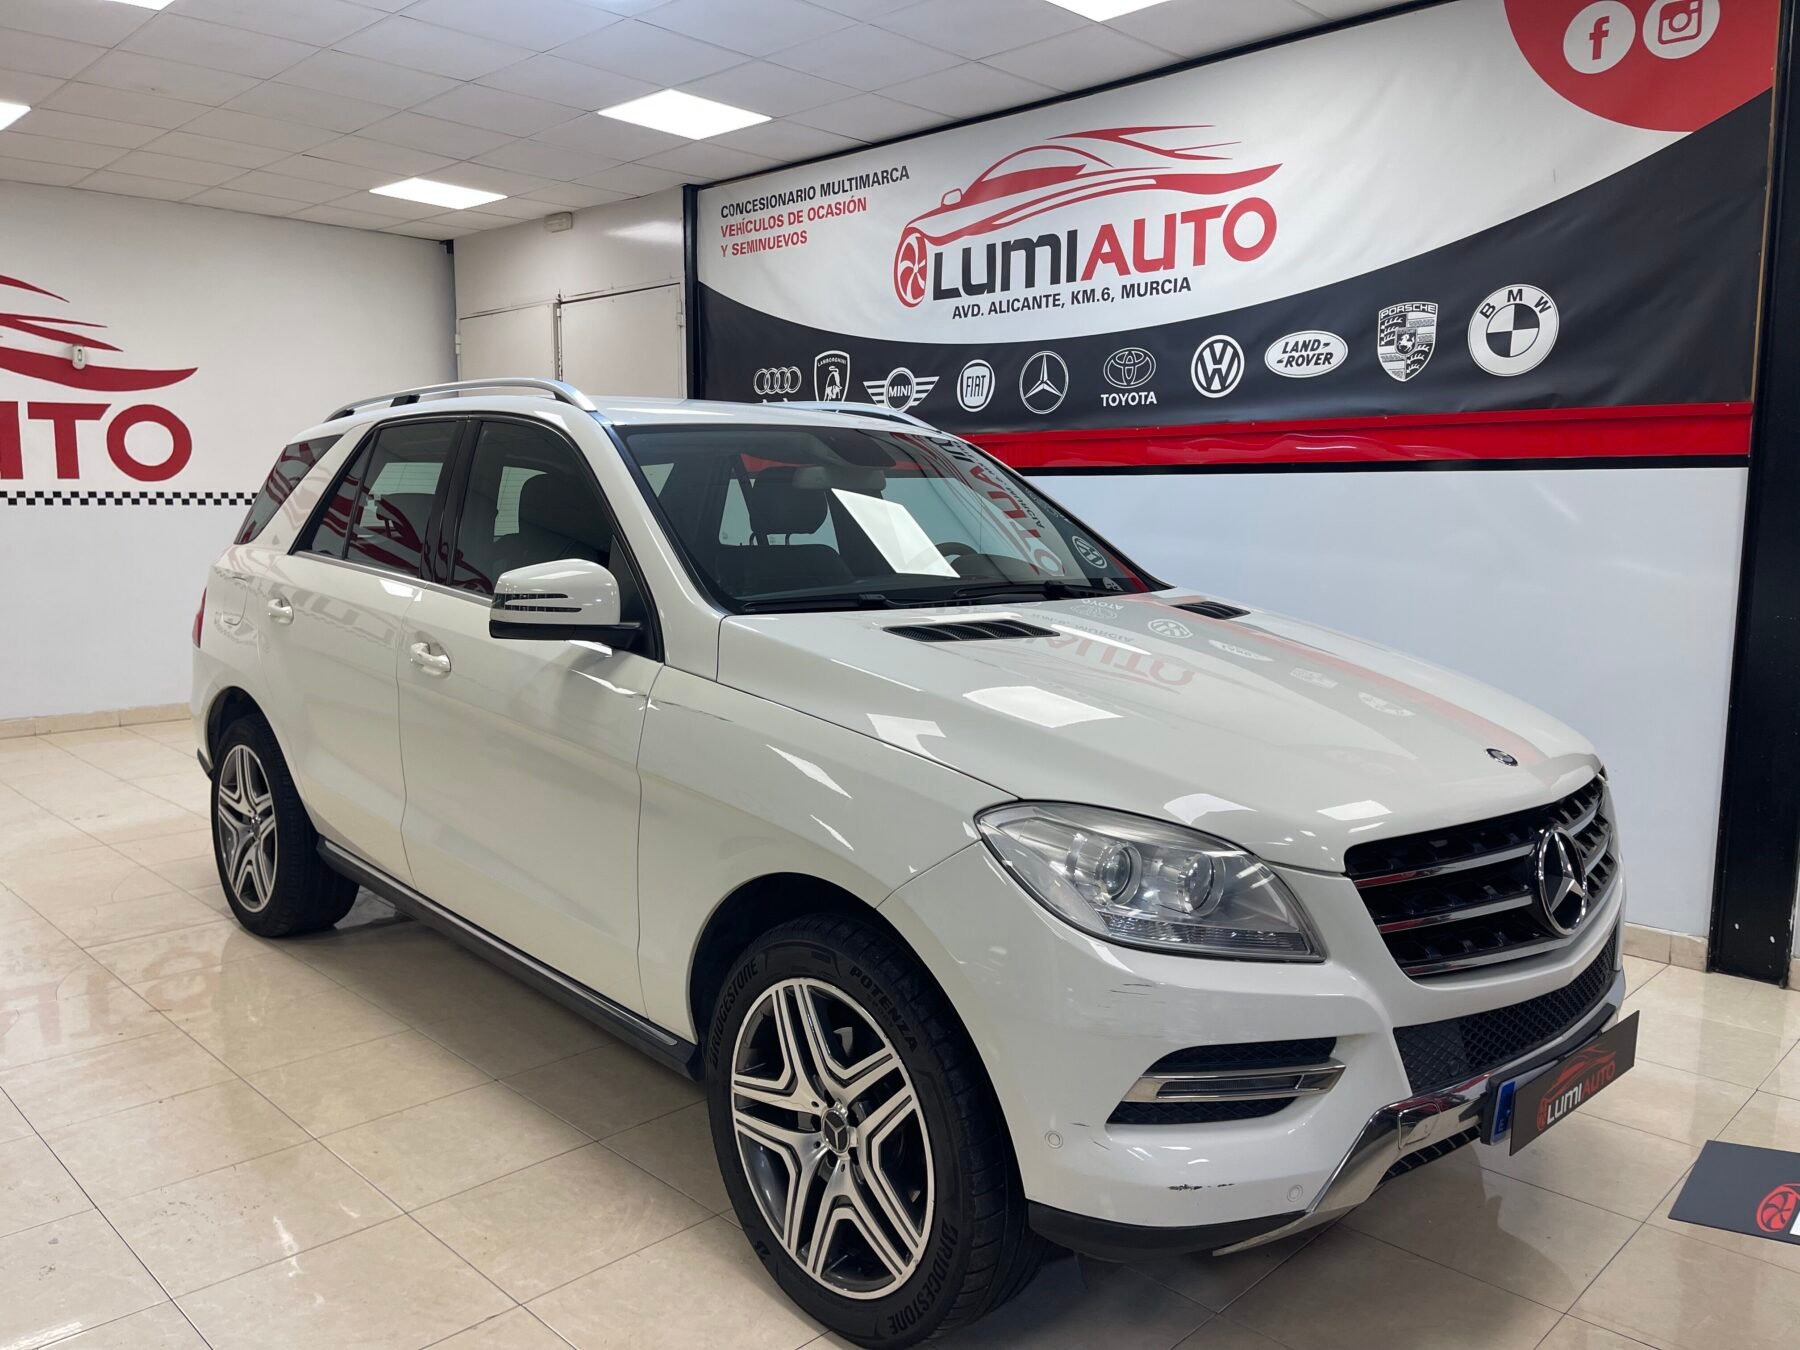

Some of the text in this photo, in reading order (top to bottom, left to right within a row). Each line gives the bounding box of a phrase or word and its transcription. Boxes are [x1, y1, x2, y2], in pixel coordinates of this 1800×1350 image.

[720, 165, 910, 219] CONCESIONARIO MULTIMARCA
[720, 195, 868, 238] VEHÍCULOS DE OCASIÓN
[720, 230, 808, 258] Y SEMINUEVOS
[952, 276, 1192, 320] AVD. ALICANTE, KM.6, MURCIA
[1479, 288, 1552, 320] BMW
[1381, 304, 1436, 319] PORSCHE
[1281, 338, 1322, 355] LAND
[1283, 352, 1334, 369] ROVER
[888, 384, 912, 398] MINI
[965, 374, 987, 398] FIAT
[1100, 391, 1157, 408] TOYOTA
